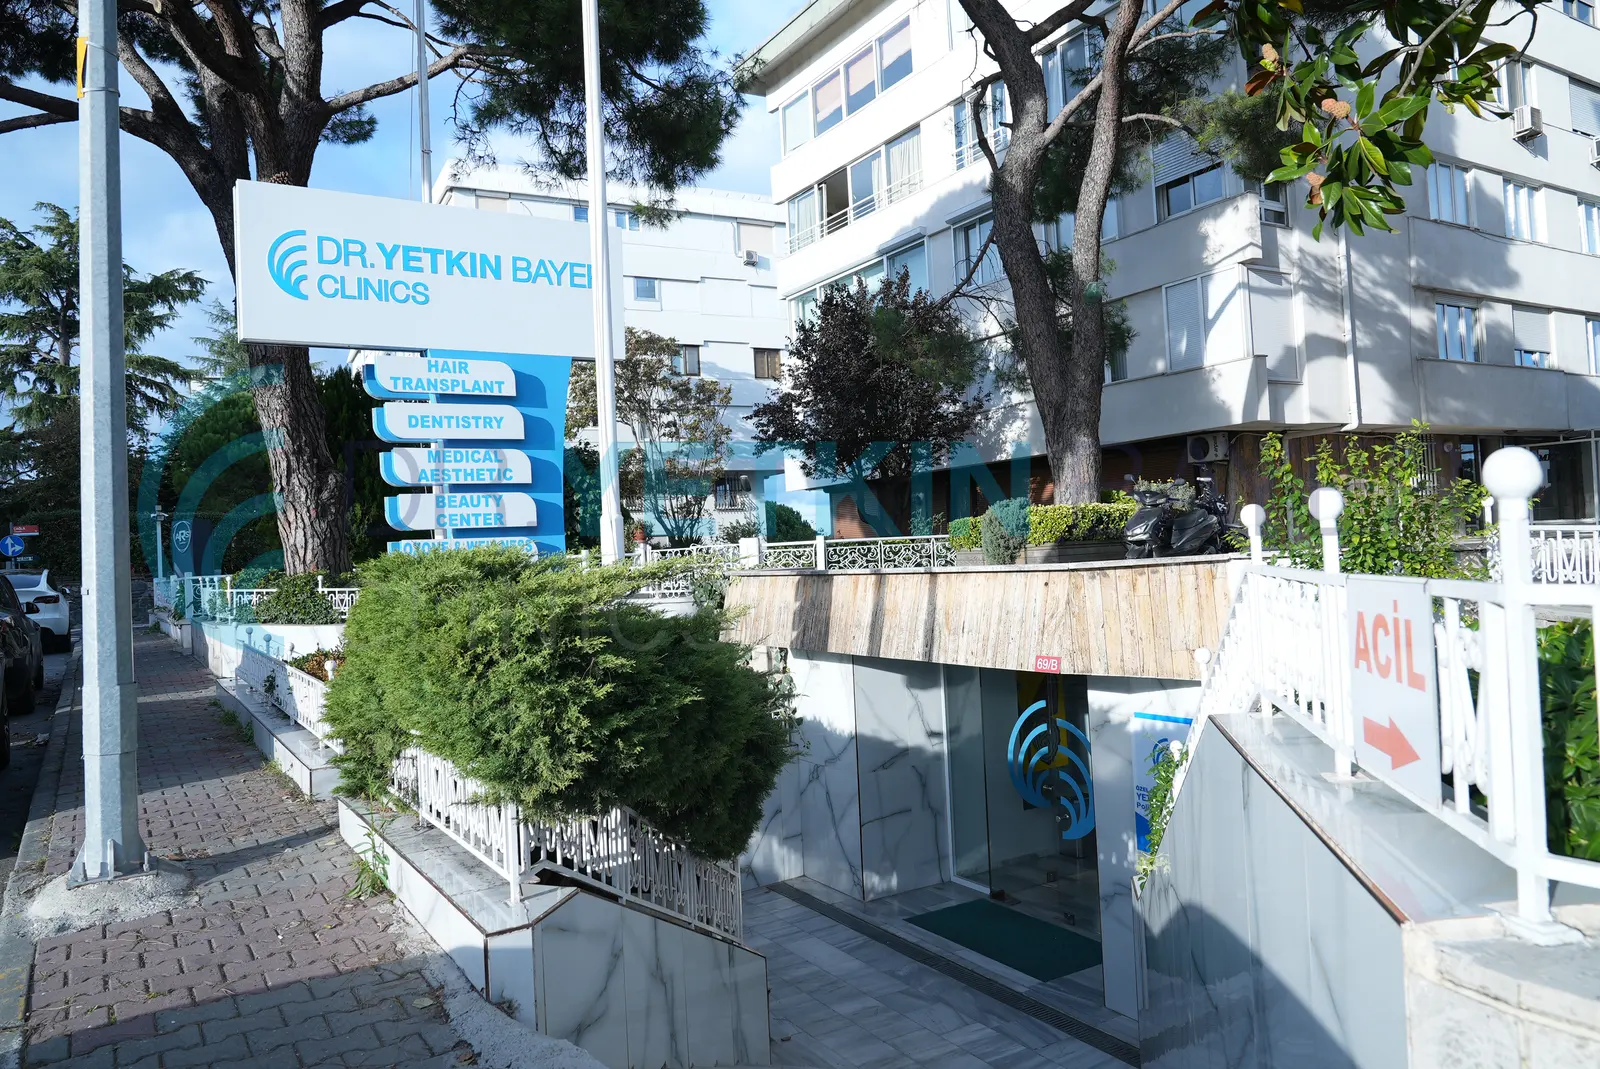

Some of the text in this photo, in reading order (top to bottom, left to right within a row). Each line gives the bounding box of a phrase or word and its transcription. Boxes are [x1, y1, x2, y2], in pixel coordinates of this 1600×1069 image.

[316, 274, 430, 305] CLINICS
[427, 360, 470, 375] HAIR
[390, 377, 505, 394] TRANSPLANT
[407, 415, 505, 429] DENTISTRY
[427, 450, 504, 464] MEDICAL
[418, 468, 514, 482] AESTHETIC
[436, 495, 504, 509] BEAUTY
[436, 513, 505, 527] CENTER
[1354, 599, 1425, 692] ACİL
[1037, 659, 1058, 671] 69/B
